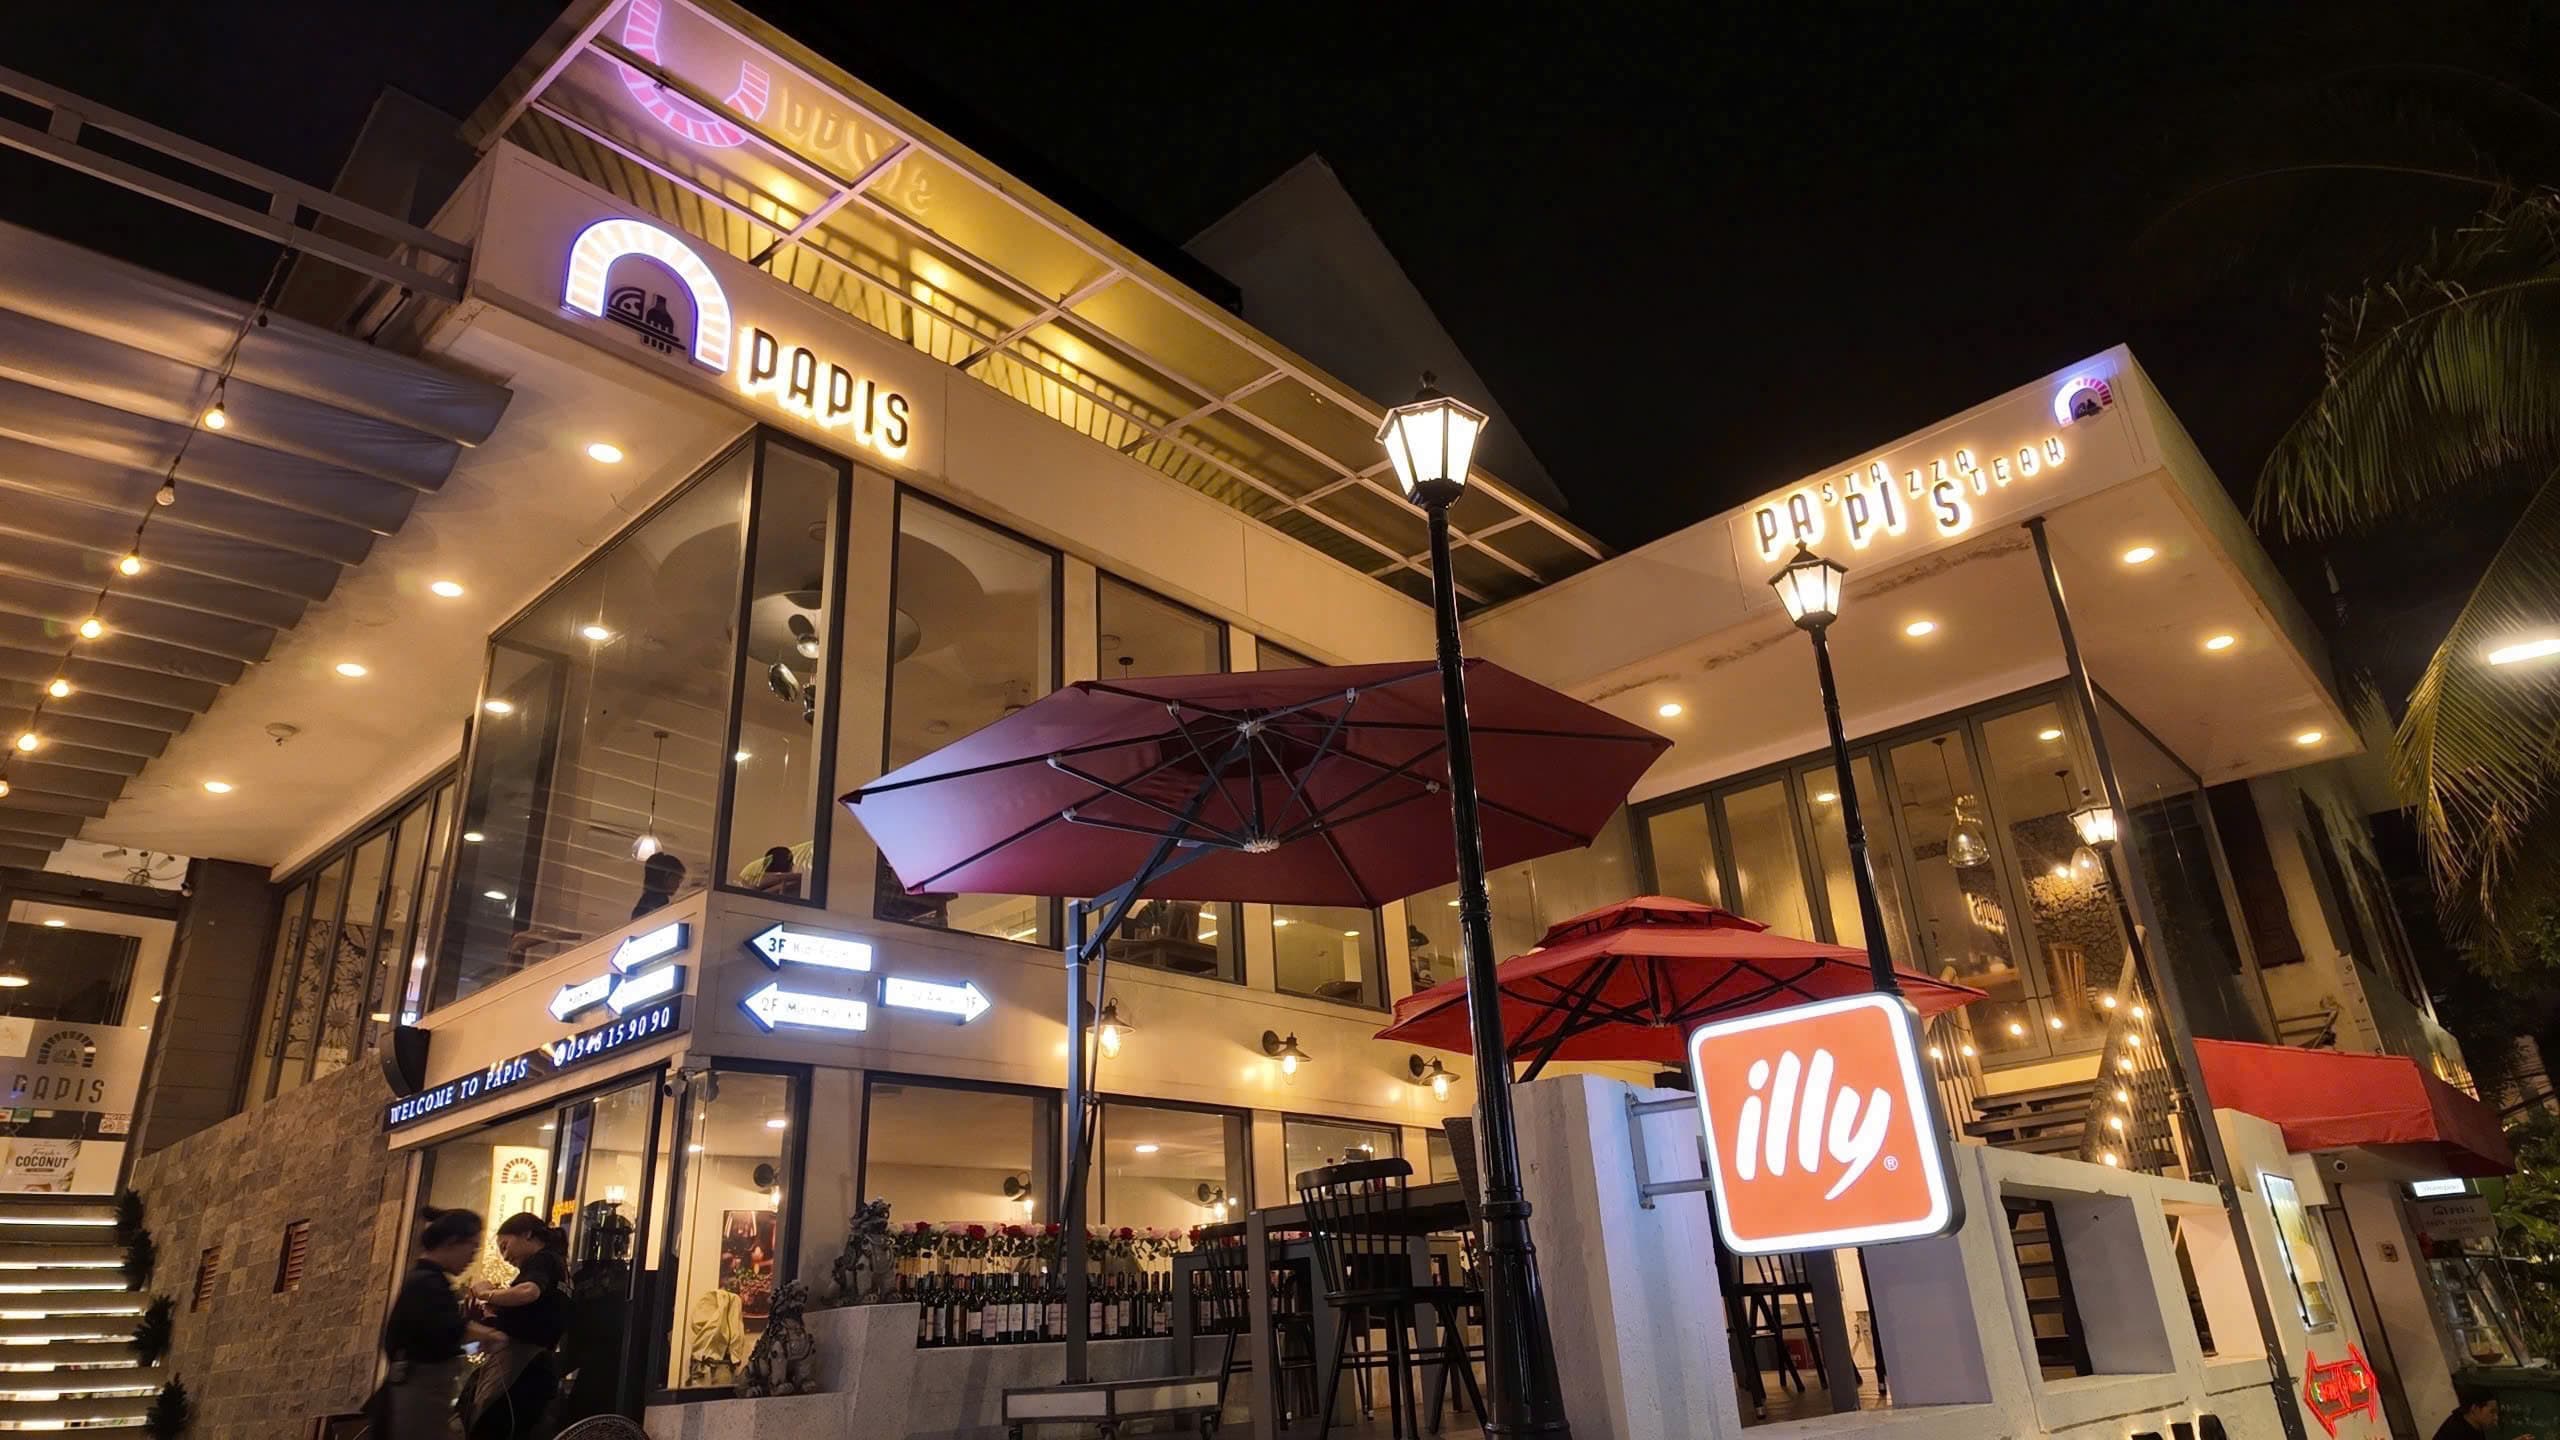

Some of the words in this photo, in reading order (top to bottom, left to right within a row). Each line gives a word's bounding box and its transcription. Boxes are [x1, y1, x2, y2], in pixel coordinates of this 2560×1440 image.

[750, 327, 910, 450] PAPIS
[768, 938, 787, 953] 3F
[390, 1086, 455, 1124] WELCOME
[461, 1077, 478, 1099] TO
[606, 1023, 624, 1048] 15
[628, 1016, 647, 1040] 90
[650, 1006, 670, 1032] 90
[15, 1155, 69, 1168] COCONUT
[1736, 1049, 1892, 1201] illy
